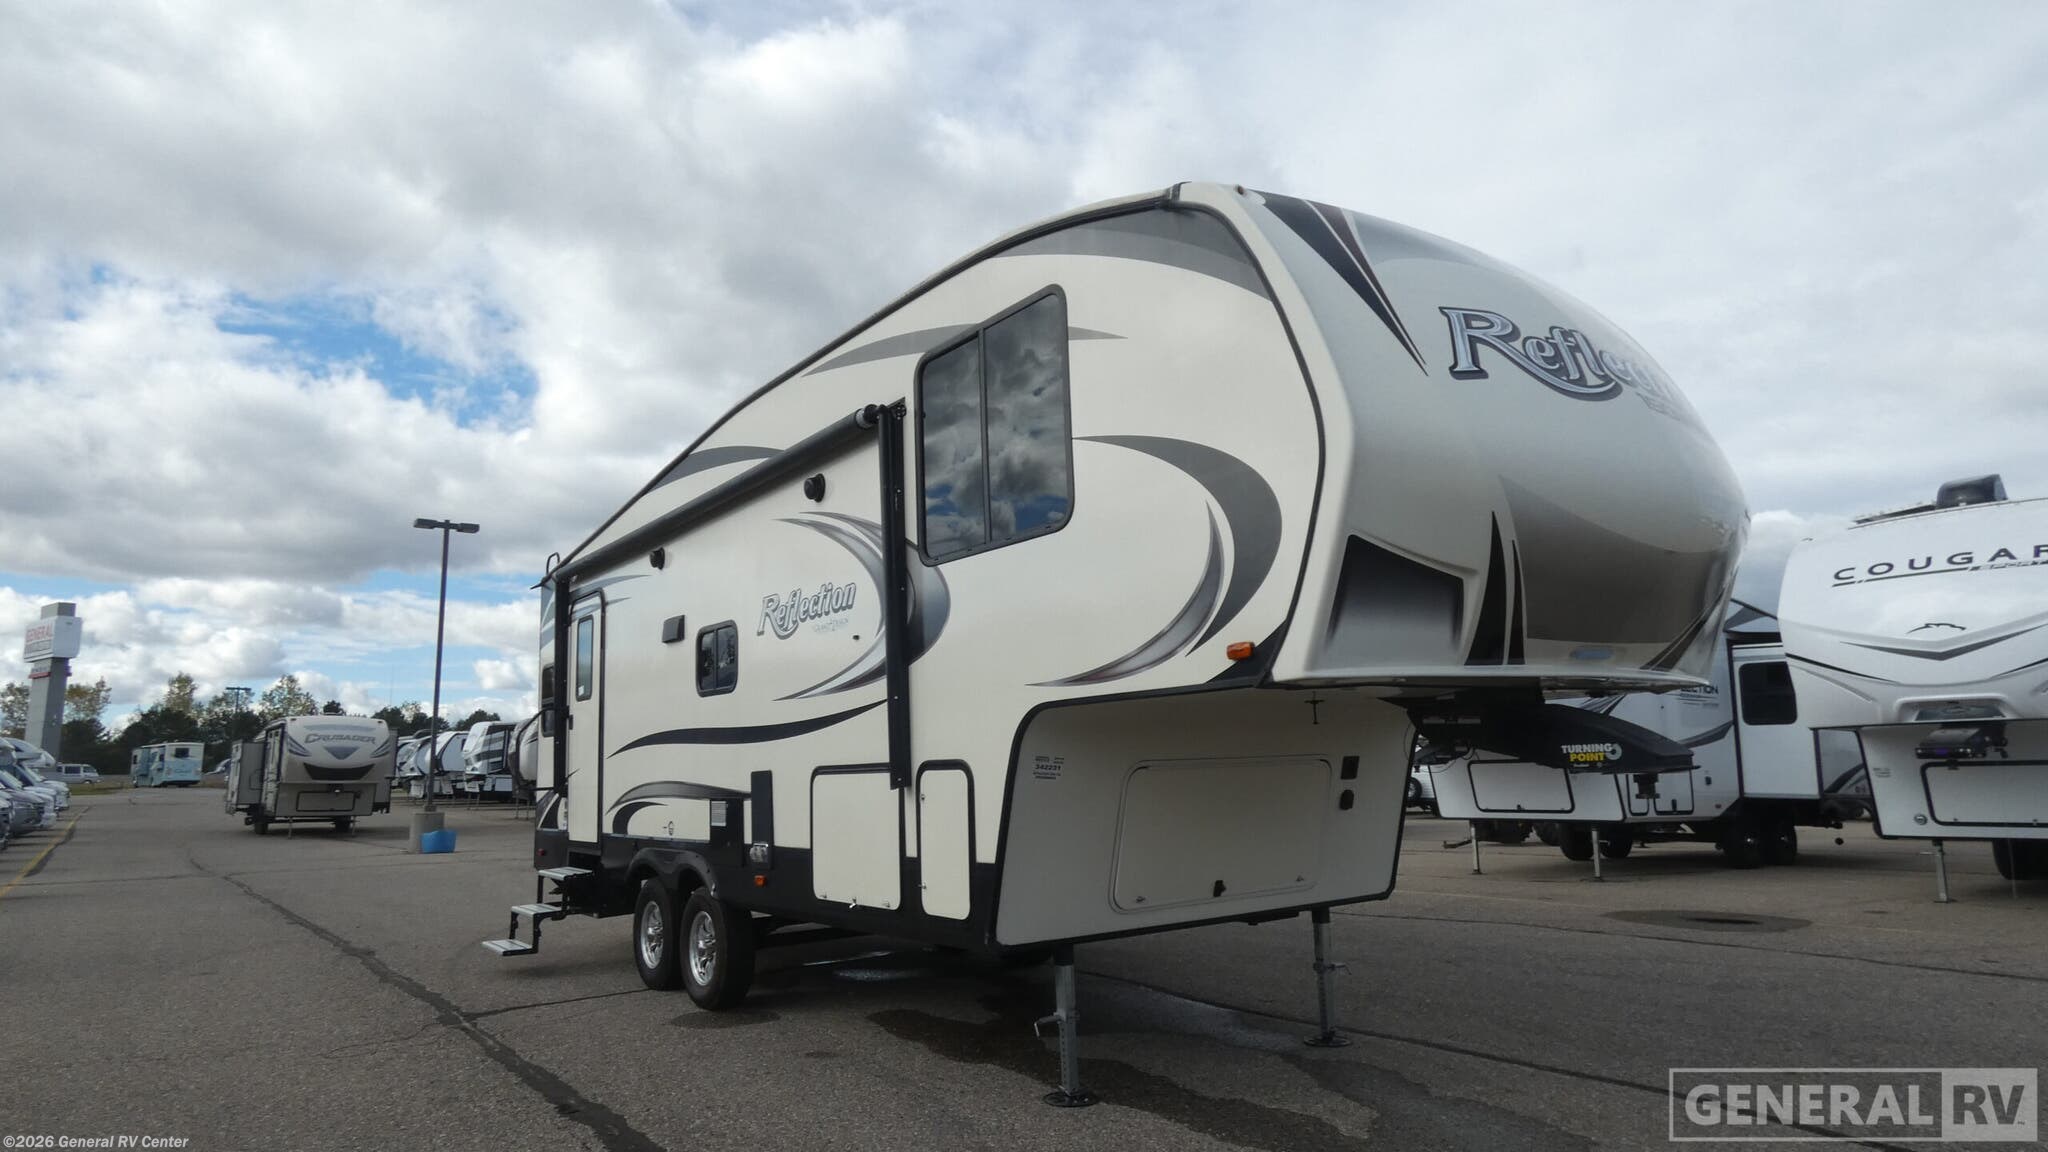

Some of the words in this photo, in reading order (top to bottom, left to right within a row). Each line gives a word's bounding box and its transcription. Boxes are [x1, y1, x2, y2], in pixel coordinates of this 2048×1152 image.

[1834, 544, 2048, 581] COUGAR
[757, 582, 857, 640] Reflection
[304, 733, 376, 744] CRUSADER
[1561, 743, 1612, 753] TURNING
[1569, 752, 1605, 762] POINT
